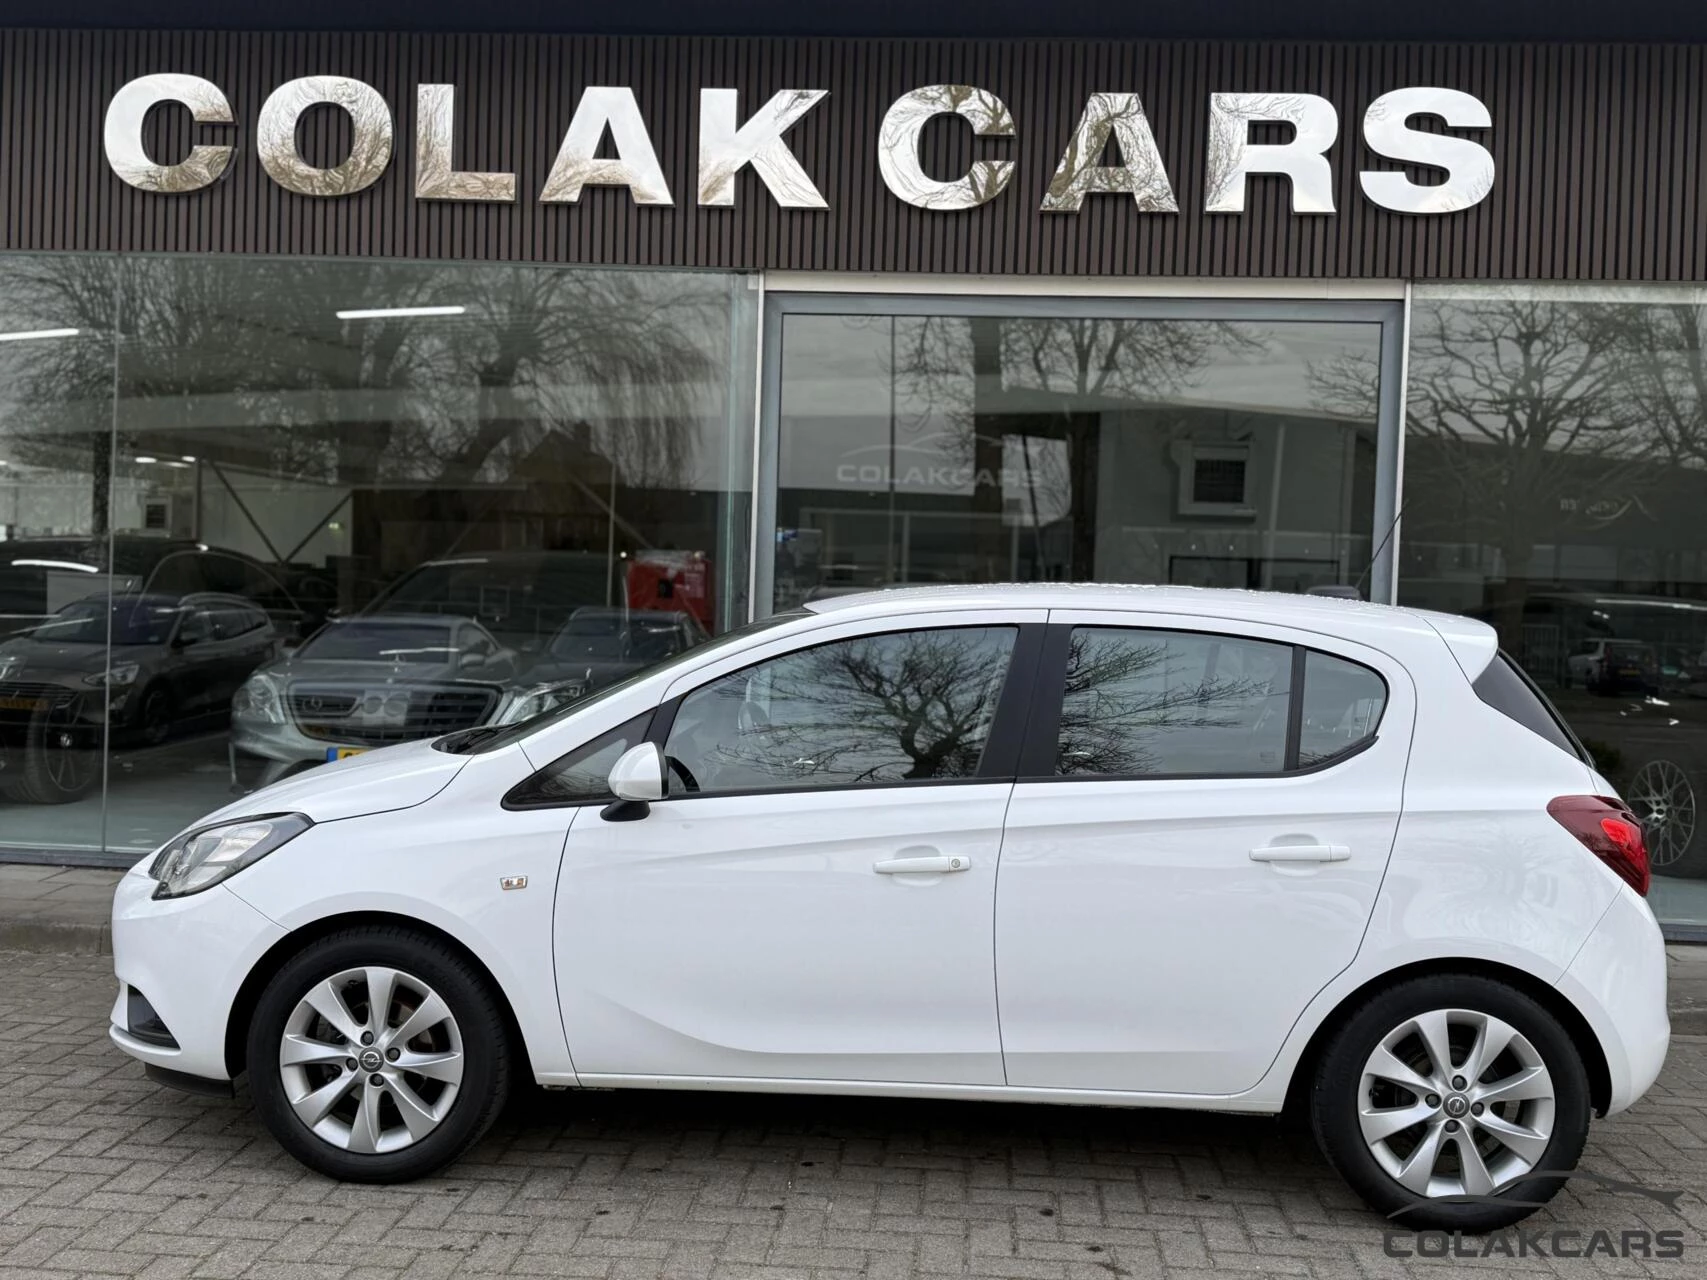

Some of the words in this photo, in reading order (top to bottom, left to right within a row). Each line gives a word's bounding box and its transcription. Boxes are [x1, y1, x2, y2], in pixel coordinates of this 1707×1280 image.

[104, 73, 830, 209] COLAK
[878, 84, 1496, 215] CARS
[836, 464, 1042, 488] COLAKCARS
